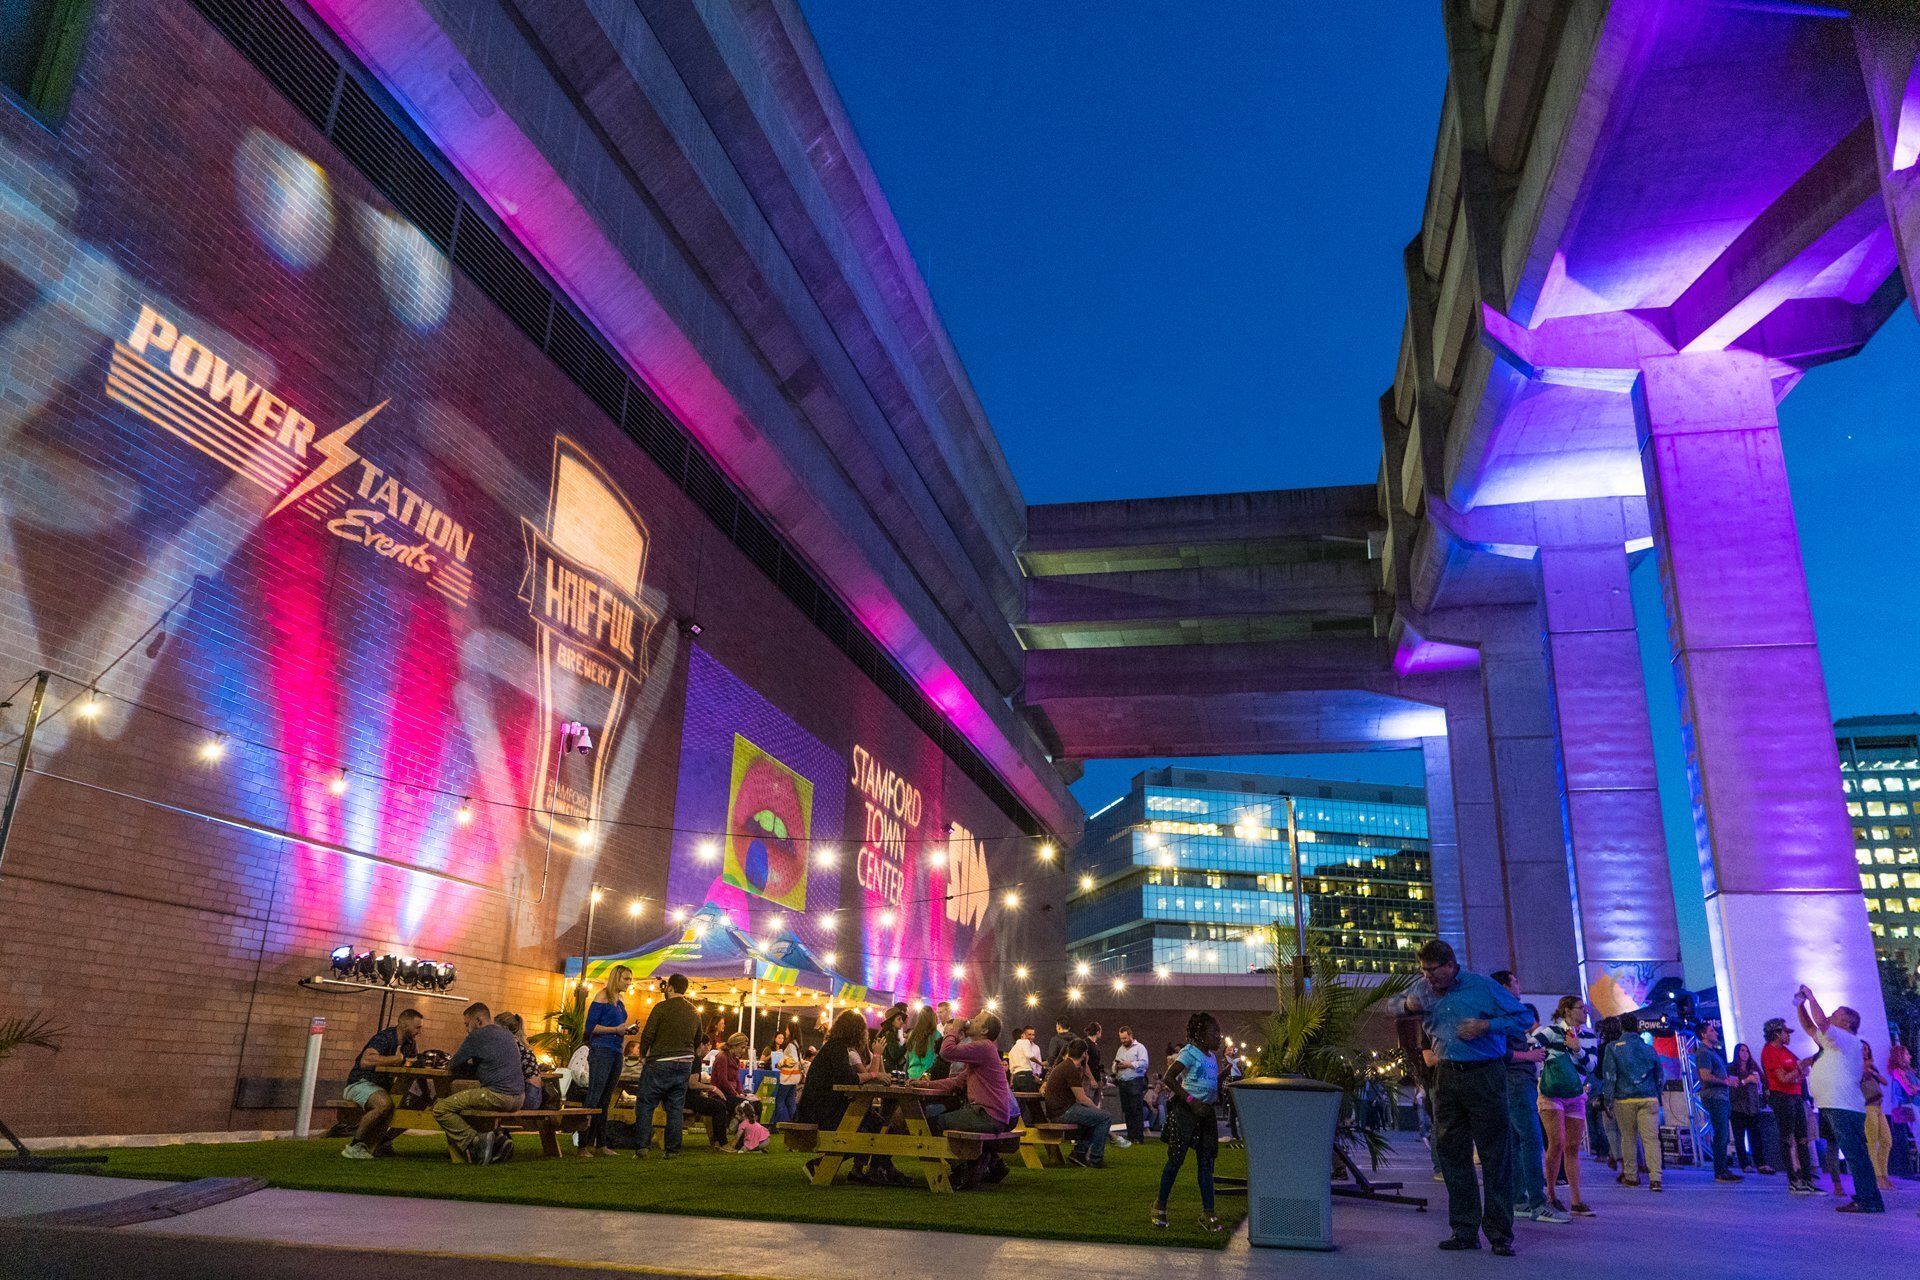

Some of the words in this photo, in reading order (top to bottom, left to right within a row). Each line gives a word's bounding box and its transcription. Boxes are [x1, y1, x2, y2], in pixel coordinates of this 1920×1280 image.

[129, 304, 315, 457] POWER
[327, 509, 437, 573] Events
[557, 642, 611, 688] BREWERY
[852, 744, 921, 826] STAMFORD
[865, 802, 906, 863] TOWN
[857, 846, 905, 913] CENTER
